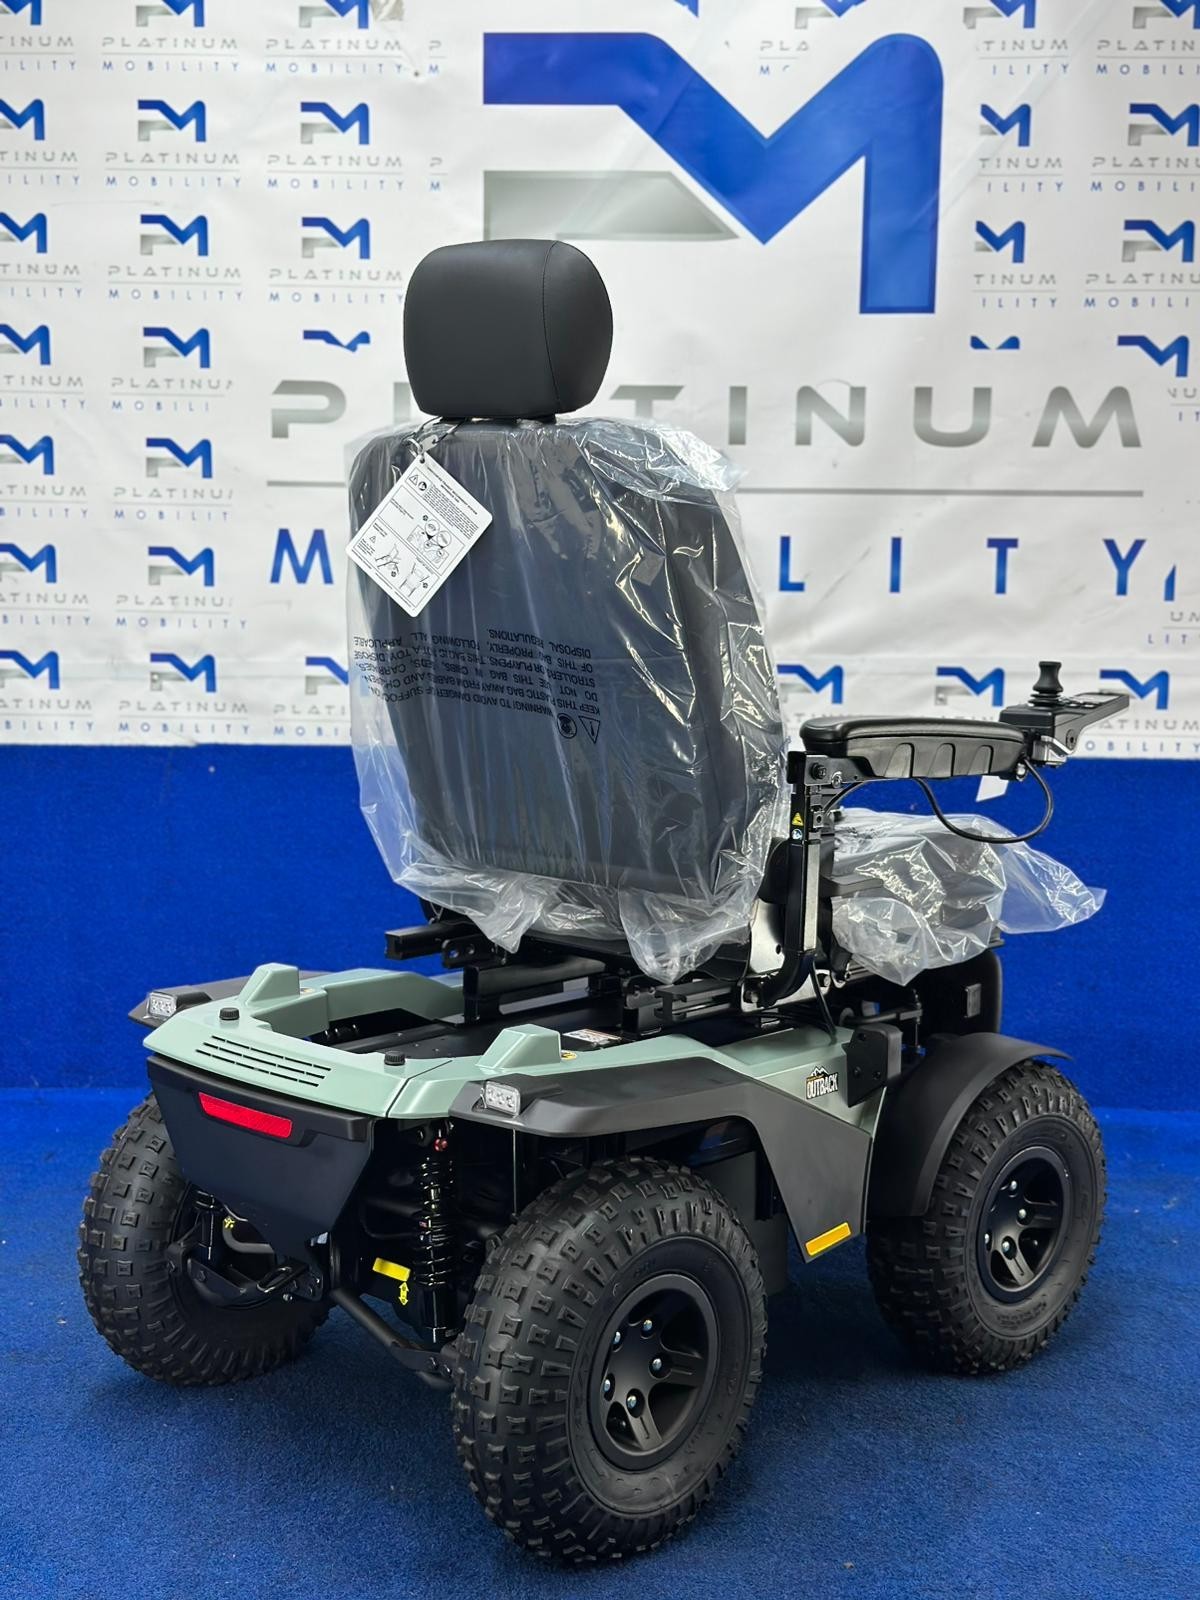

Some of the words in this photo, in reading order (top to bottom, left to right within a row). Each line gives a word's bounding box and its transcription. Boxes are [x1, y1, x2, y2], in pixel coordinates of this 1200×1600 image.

[0, 36, 74, 48] INUM
[101, 37, 239, 50] PLATINUM
[265, 38, 402, 51] PLATINUM
[976, 40, 1068, 51] TINUM
[101, 62, 240, 73] MOBILITY
[265, 63, 404, 75] MOBILITY
[104, 152, 240, 166] PLATINUM
[267, 154, 402, 167] PLATINUM
[106, 176, 240, 188] MOBILITY
[267, 178, 404, 191] MOBILITY
[107, 265, 241, 278] PLATINUM
[268, 268, 403, 282] PLATINUM
[108, 289, 242, 300] MOBILITY
[269, 292, 403, 305] MOBILITY
[0, 399, 86, 411] ILITY
[271, 379, 1142, 448] PTINUM
[0, 484, 87, 497] TINUM
[270, 528, 1146, 597] MLITY
[115, 595, 232, 608] PLATINU
[116, 617, 247, 630] MOBILITY
[354, 636, 402, 648] APPLICABLE
[486, 641, 533, 658] PROPERLY,
[548, 641, 592, 659] DISPOSAL
[557, 657, 578, 670] THIS
[581, 662, 592, 674] OF
[403, 672, 426, 686] AND
[490, 670, 508, 681] BAG
[512, 673, 533, 686] THIS
[506, 686, 524, 698] BAG
[526, 689, 555, 706] PSTIC
[560, 686, 577, 697] NOT
[584, 690, 598, 702] DO
[118, 700, 249, 713] PLATINUM
[472, 694, 497, 706] AVOID
[499, 698, 511, 709] TO
[557, 698, 577, 710] THIS
[580, 704, 600, 716] KEEP
[118, 722, 250, 735] MOBILITY
[806, 1073, 838, 1099] OUTBACK
